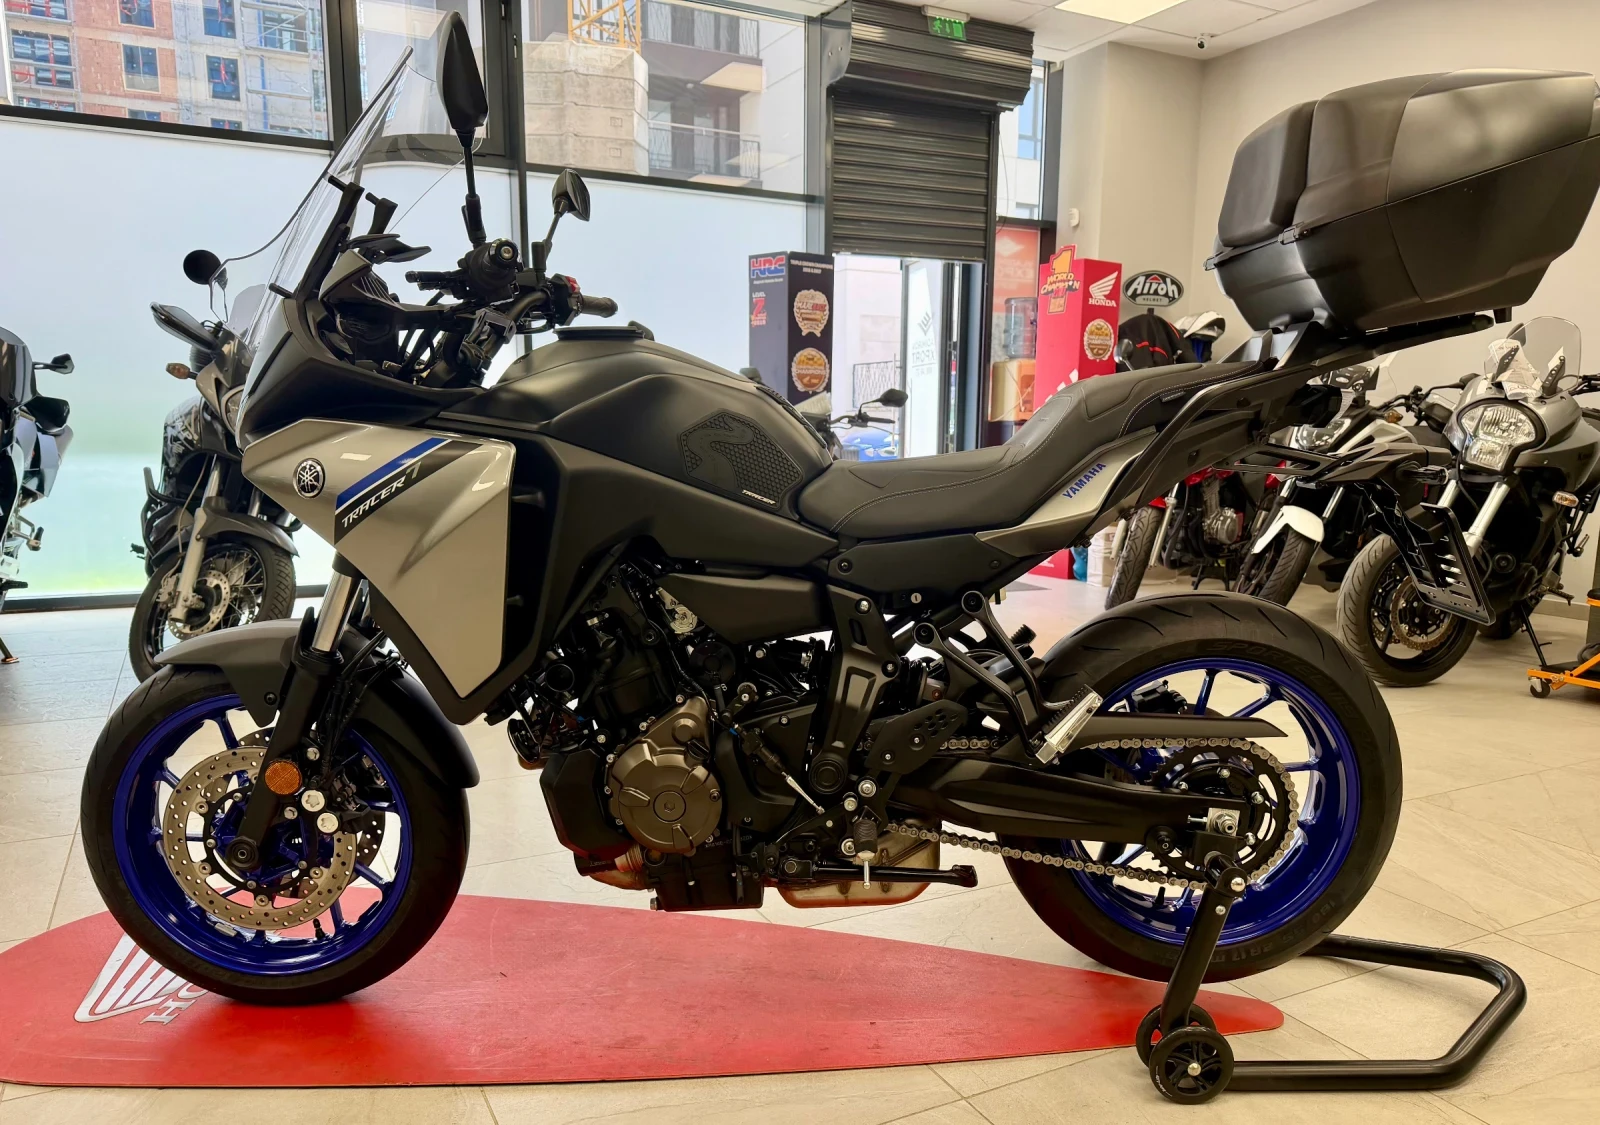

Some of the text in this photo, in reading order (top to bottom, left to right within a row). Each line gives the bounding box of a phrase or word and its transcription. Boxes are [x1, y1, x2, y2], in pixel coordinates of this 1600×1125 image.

[751, 256, 785, 278] HRC
[1047, 272, 1074, 285] WORLD
[1127, 275, 1179, 298] Airoh
[1088, 298, 1117, 307] HONDA
[1062, 463, 1106, 498] YAMAHA
[342, 461, 421, 528] TRACER 7
